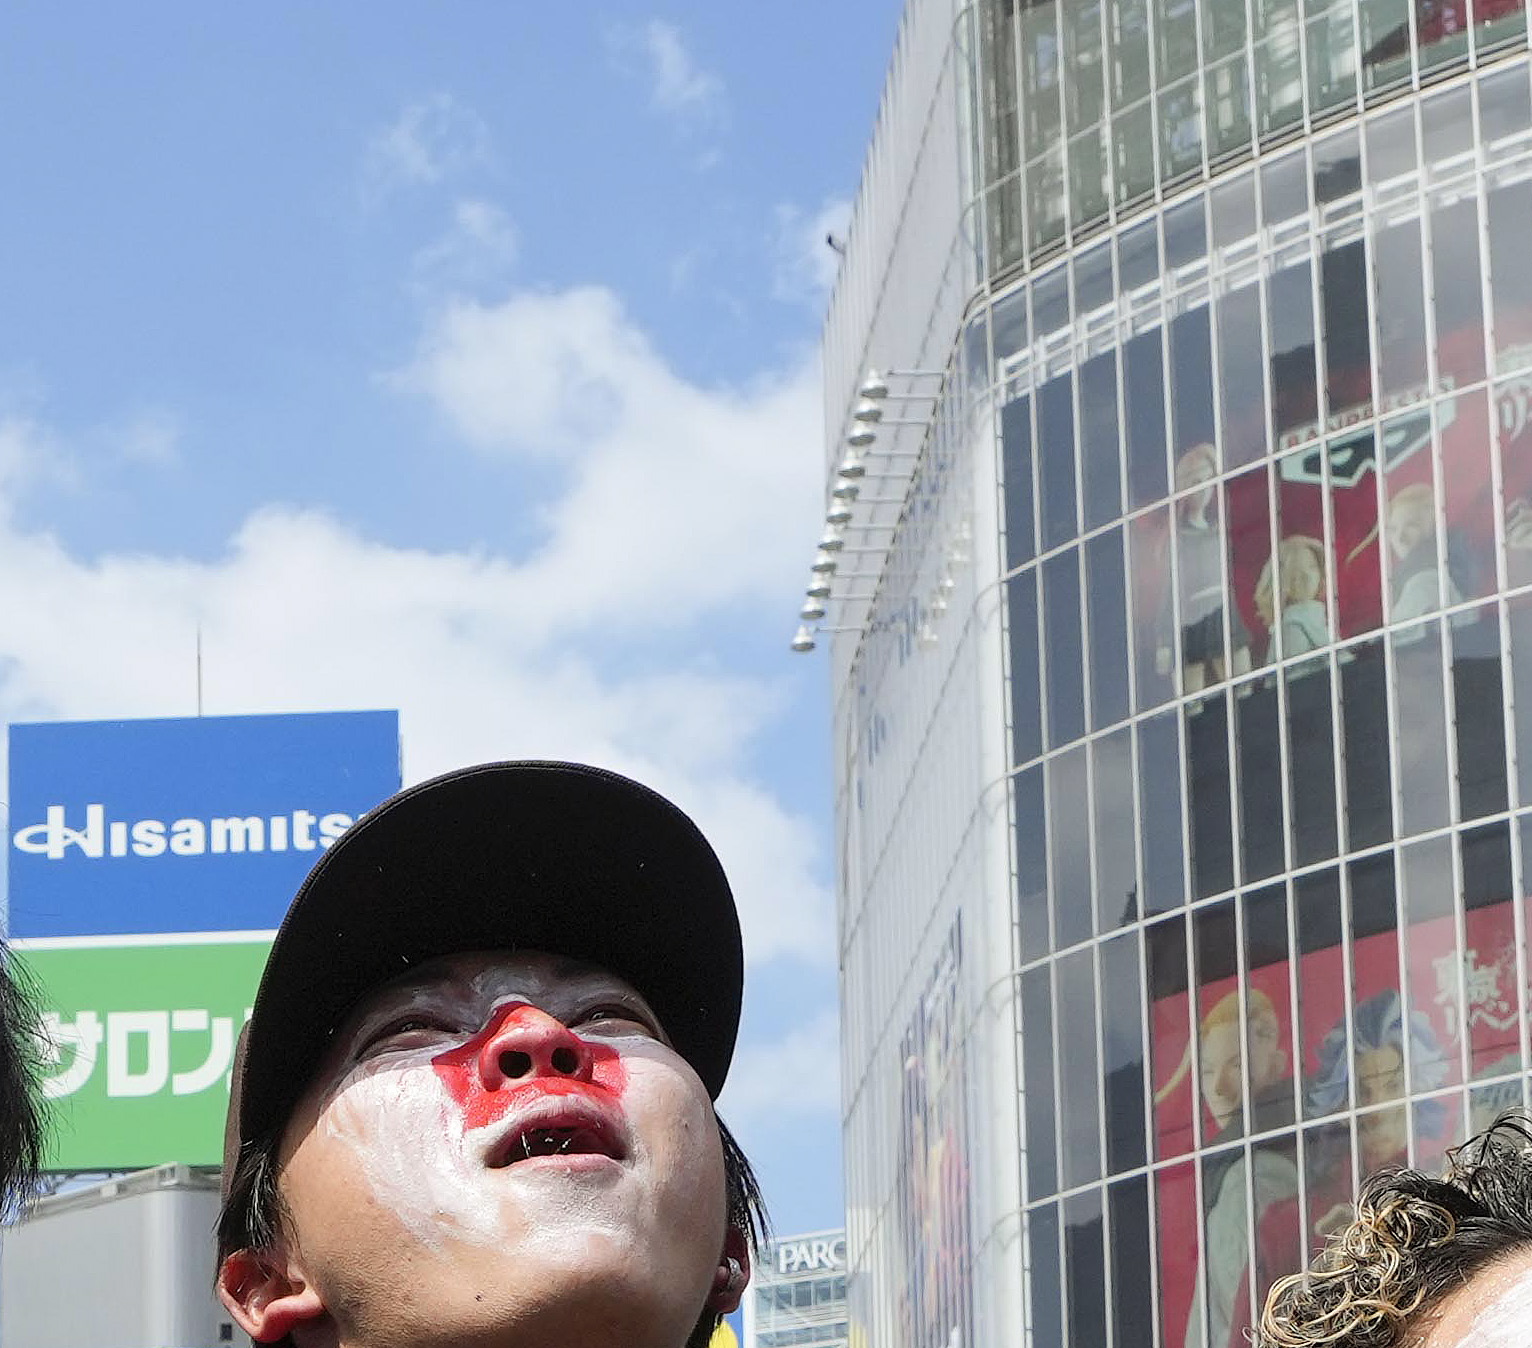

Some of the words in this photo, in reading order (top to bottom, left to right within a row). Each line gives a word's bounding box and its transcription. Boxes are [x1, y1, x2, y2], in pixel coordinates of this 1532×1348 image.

[13, 804, 374, 860] Hisamits
[37, 1009, 254, 1098] サロン
